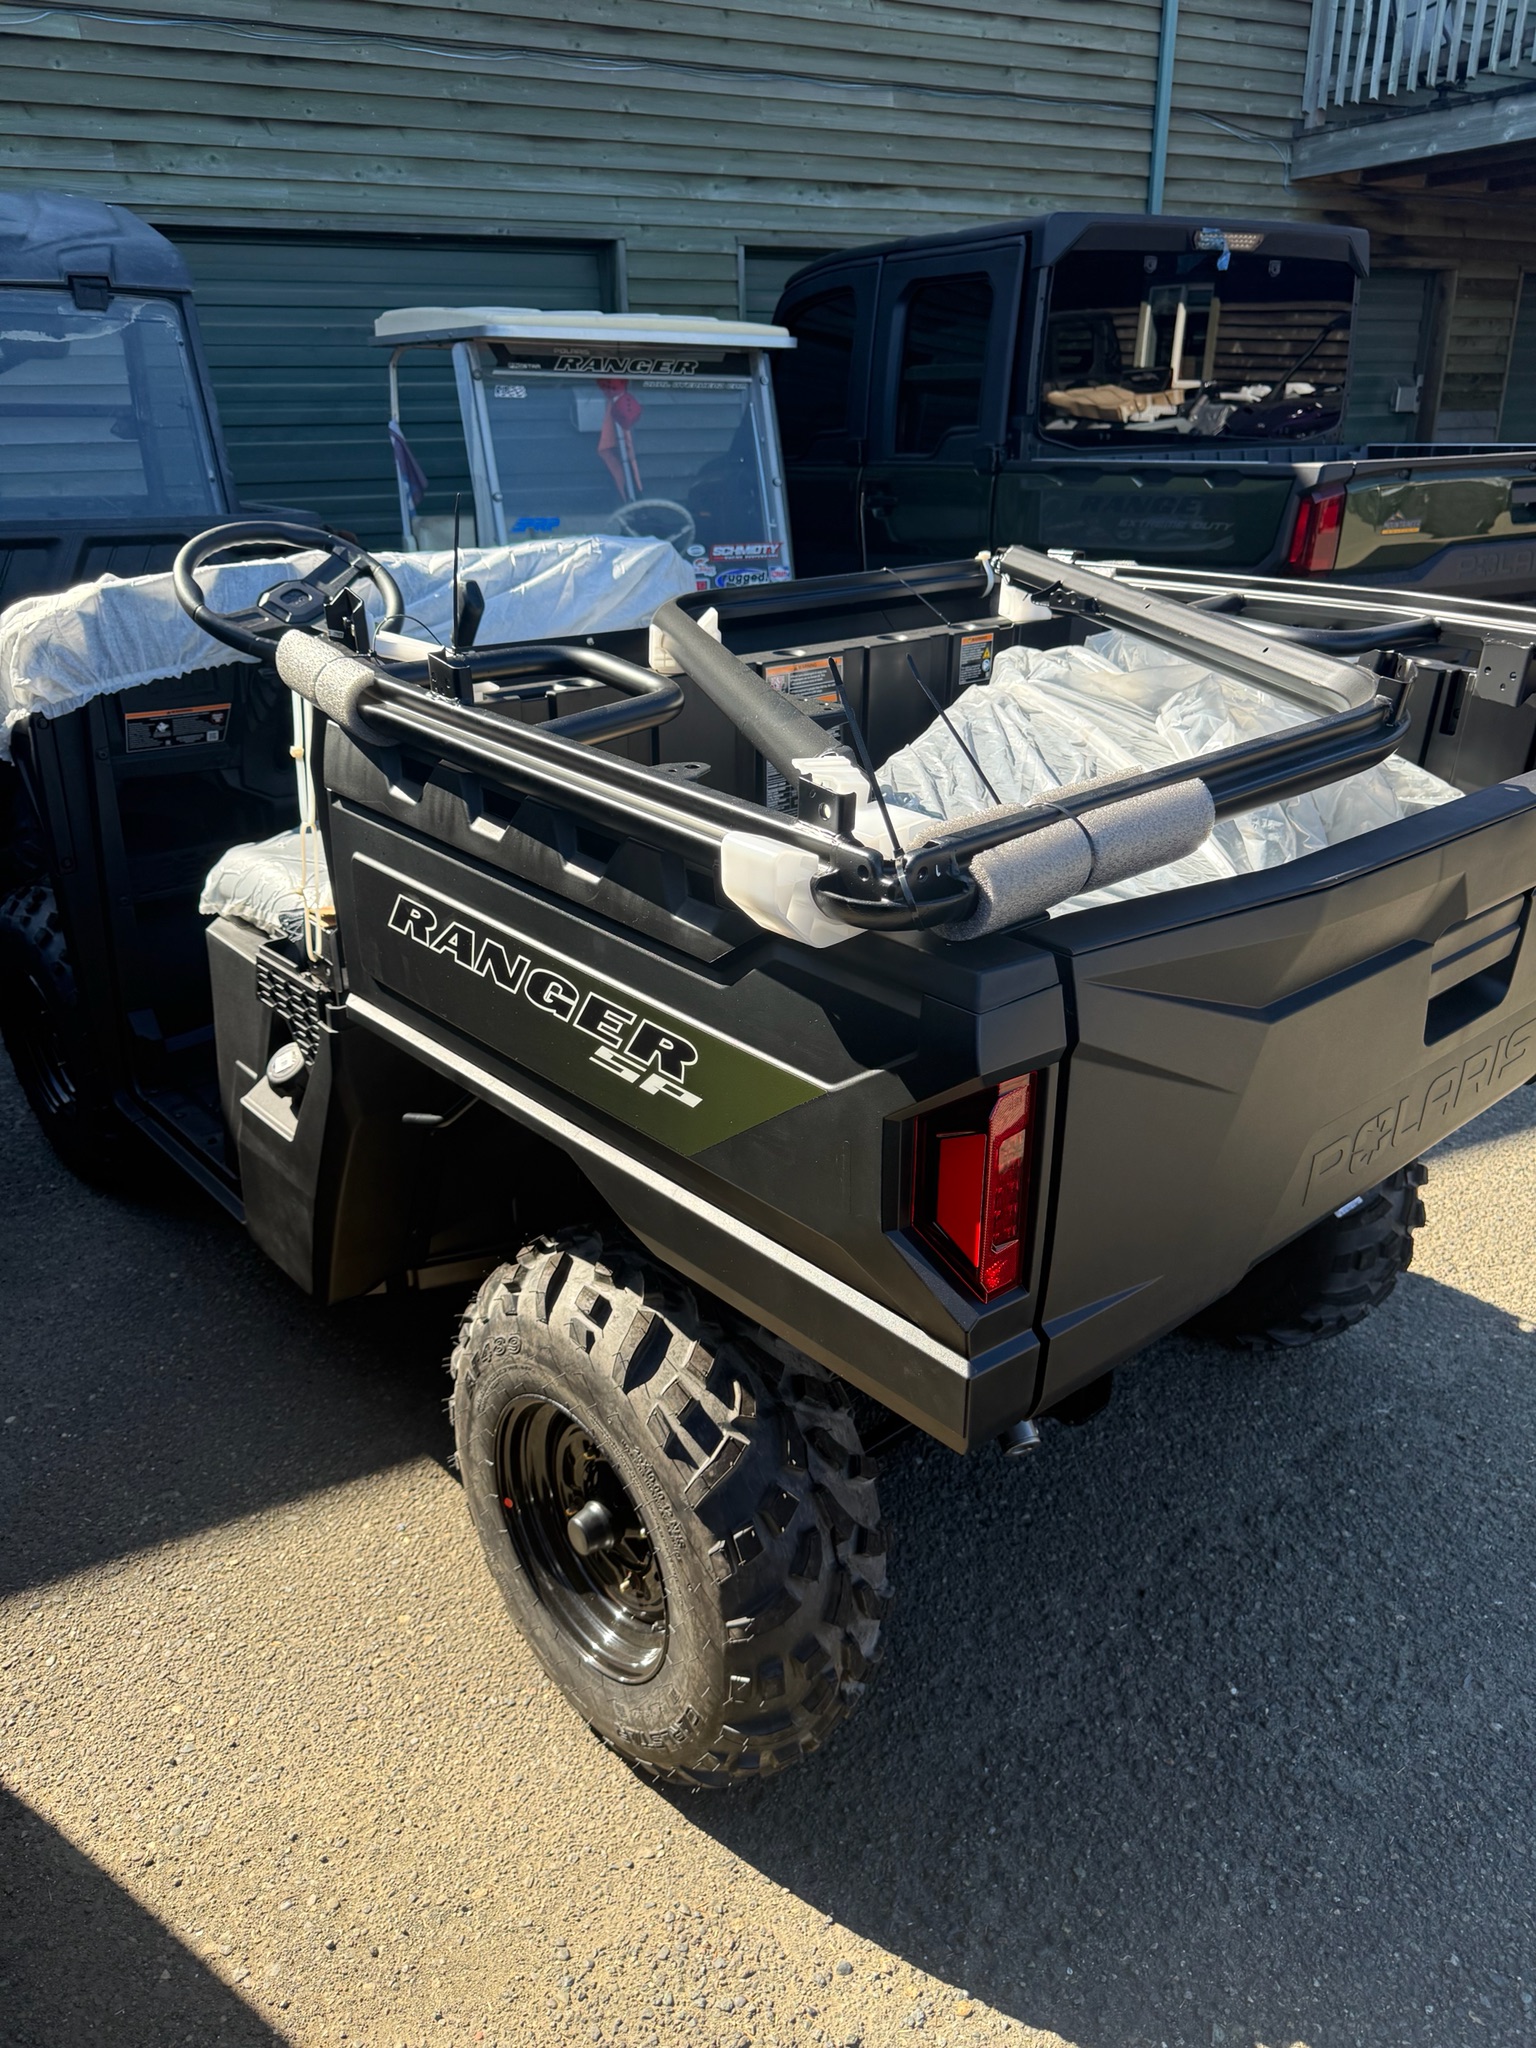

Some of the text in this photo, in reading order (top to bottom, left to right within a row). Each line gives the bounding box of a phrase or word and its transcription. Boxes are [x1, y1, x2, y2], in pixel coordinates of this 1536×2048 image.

[553, 355, 699, 376] RANGER
[1191, 522, 1236, 532] DUTY
[388, 893, 699, 1084] RANGER
[589, 1046, 703, 1108] SP
[1301, 1018, 1536, 1207] POLARIS
